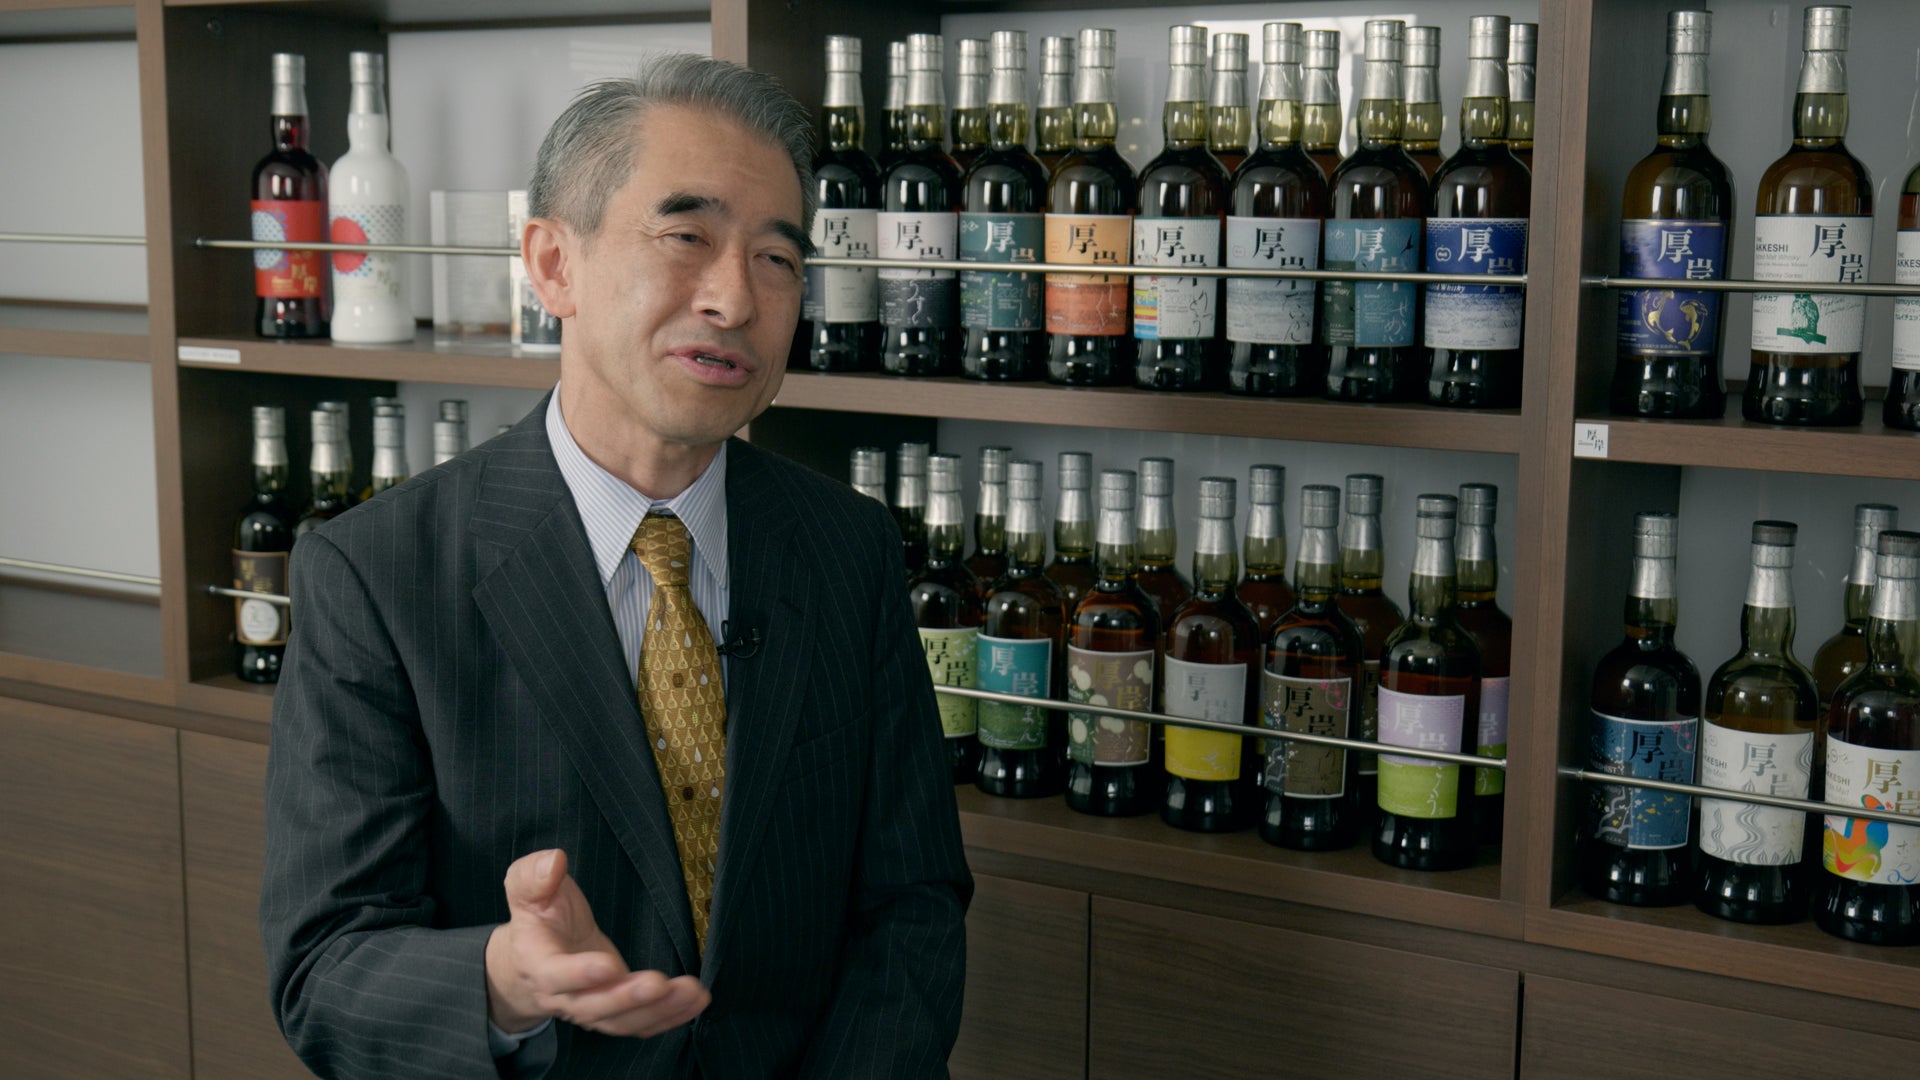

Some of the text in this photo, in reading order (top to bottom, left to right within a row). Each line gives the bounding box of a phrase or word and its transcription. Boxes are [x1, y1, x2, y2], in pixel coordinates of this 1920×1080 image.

[822, 216, 870, 272] 厚岸
[896, 220, 945, 277] 厚岸
[984, 220, 1036, 280] 厚岸
[1067, 223, 1118, 283] 厚岸
[1155, 226, 1208, 287] 厚岸
[1252, 227, 1306, 290] 厚岸
[1457, 227, 1515, 293] 厚岸
[1657, 229, 1714, 293] 厚岸
[1810, 222, 1863, 283] 厚岸
[925, 637, 969, 686] 厚岸
[991, 645, 1038, 695] 厚岸
[1283, 686, 1335, 736] 厚岸
[1629, 730, 1684, 783] 厚岸
